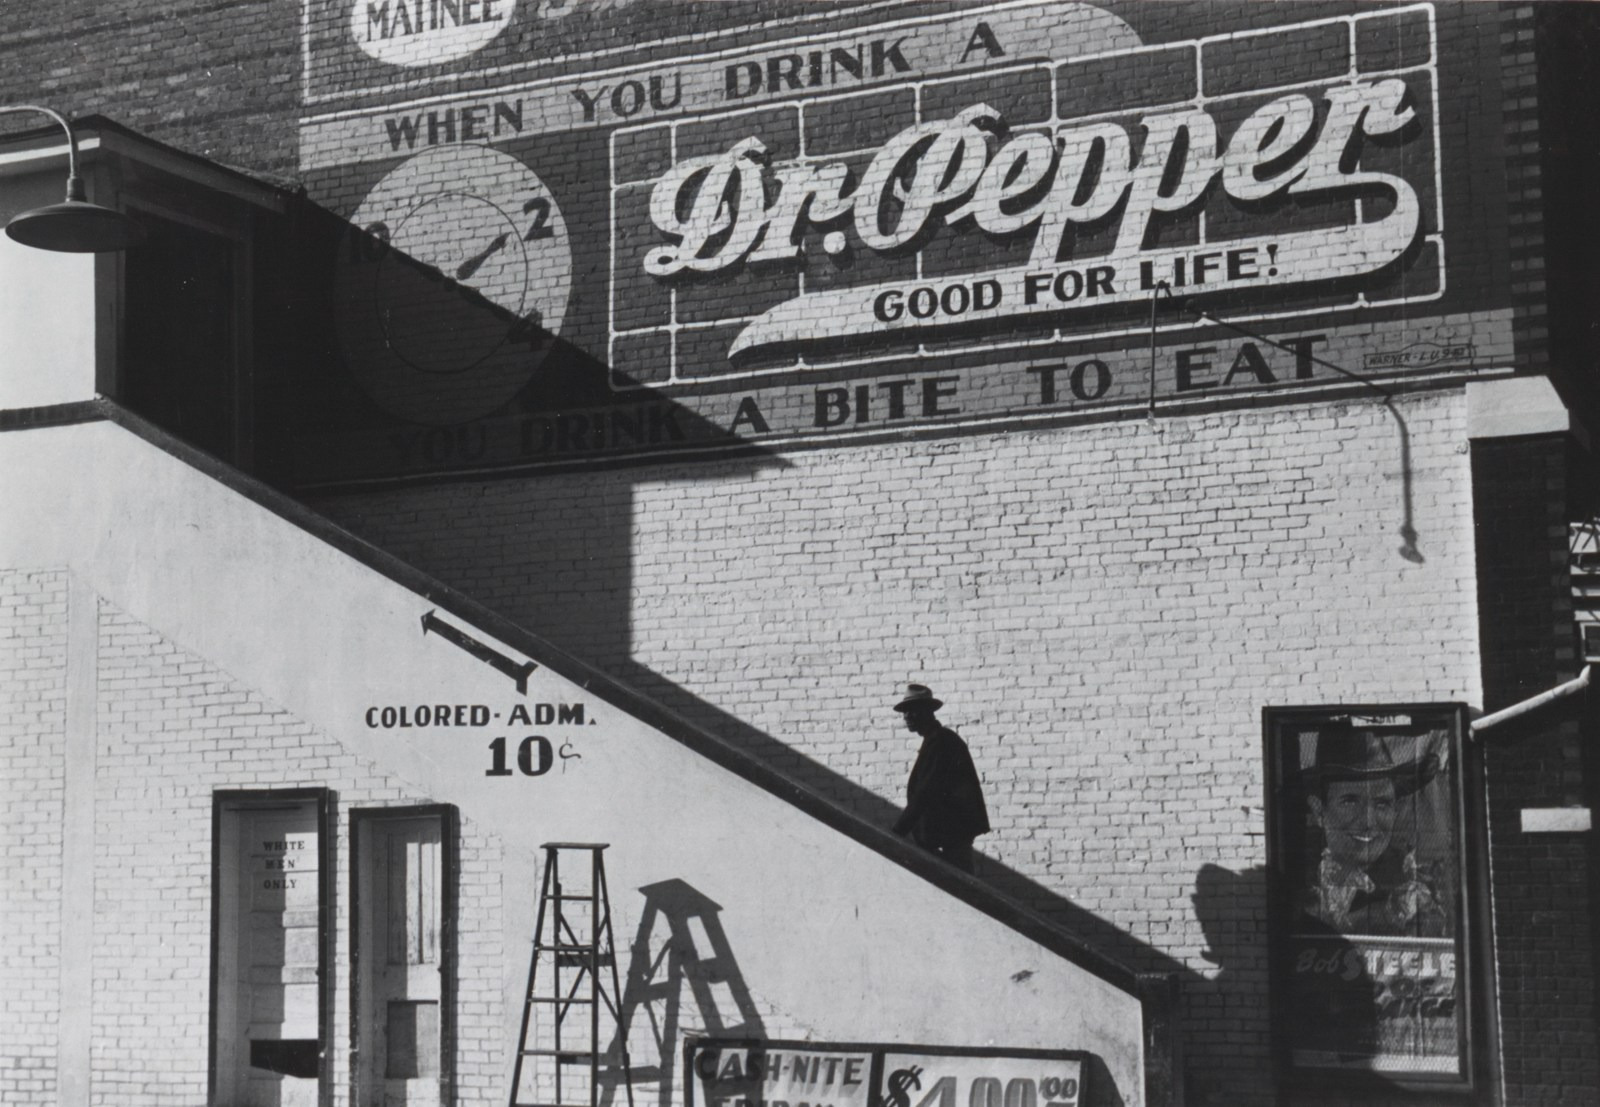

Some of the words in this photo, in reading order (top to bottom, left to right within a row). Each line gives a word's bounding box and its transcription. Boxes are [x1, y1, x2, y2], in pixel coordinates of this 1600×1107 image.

[384, 99, 523, 151] WHEN
[569, 71, 681, 122] YOU
[724, 36, 912, 100] DRINK
[960, 22, 1005, 63] A
[642, 136, 853, 277] Dr.
[854, 79, 1416, 268] Pepper
[523, 198, 554, 241] 2
[873, 279, 1002, 322] GOOD
[1024, 265, 1116, 305] FOR
[1140, 244, 1278, 291] LIFE!
[1369, 352, 1411, 366] WARNER
[388, 424, 487, 466] YOU
[520, 405, 686, 455] DRINK
[728, 397, 771, 434] A
[814, 375, 960, 428] BITE
[1026, 359, 1112, 405] TO
[1176, 334, 1327, 392] EAT
[507, 703, 598, 727] ADM.
[263, 840, 305, 851] WHITE
[265, 859, 295, 870] MEN
[263, 879, 297, 889] ONLY
[1296, 948, 1340, 976] Bob
[1340, 946, 1456, 983] STEELE
[694, 1052, 865, 1087] CASH-NITE
